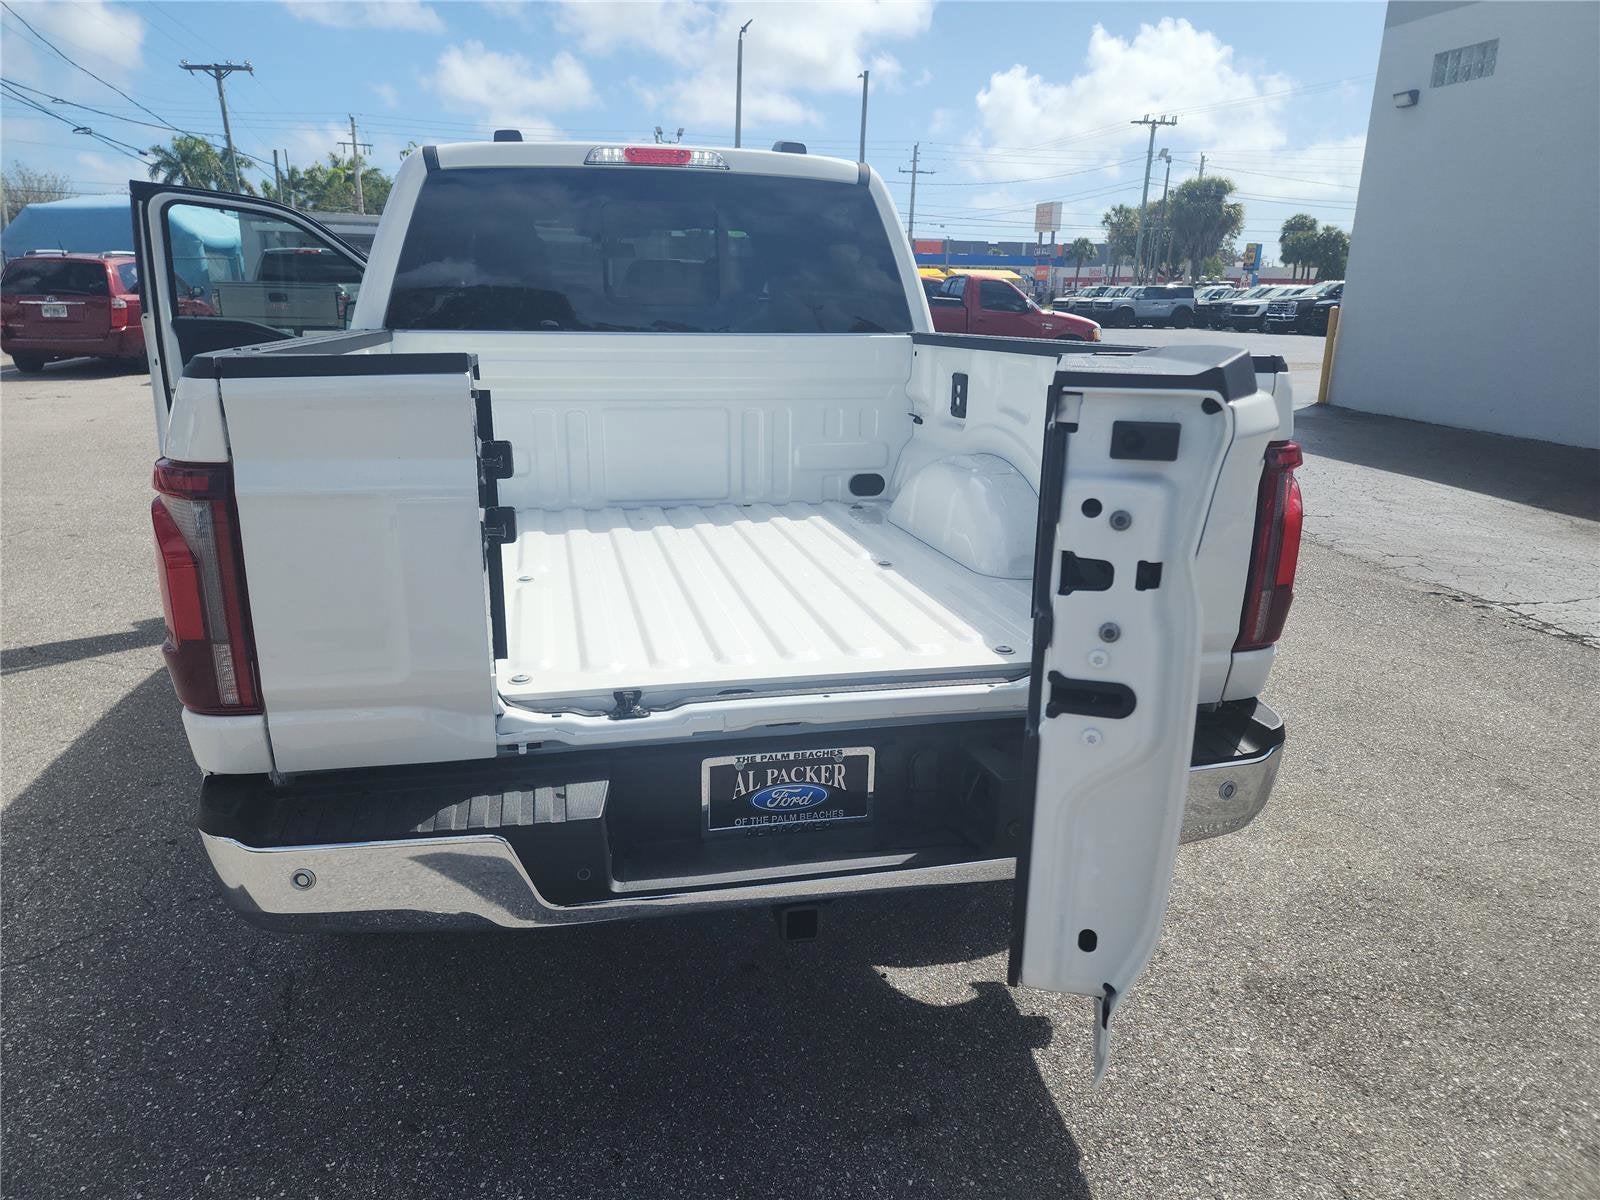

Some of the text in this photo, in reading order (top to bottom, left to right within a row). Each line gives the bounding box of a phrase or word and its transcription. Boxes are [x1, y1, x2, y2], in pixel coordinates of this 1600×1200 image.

[735, 749, 843, 764] THE PALM BEACHES
[732, 763, 847, 800] AL PACKER
[766, 787, 813, 808] Ford
[734, 809, 844, 826] OF THE PALM BEACHES
